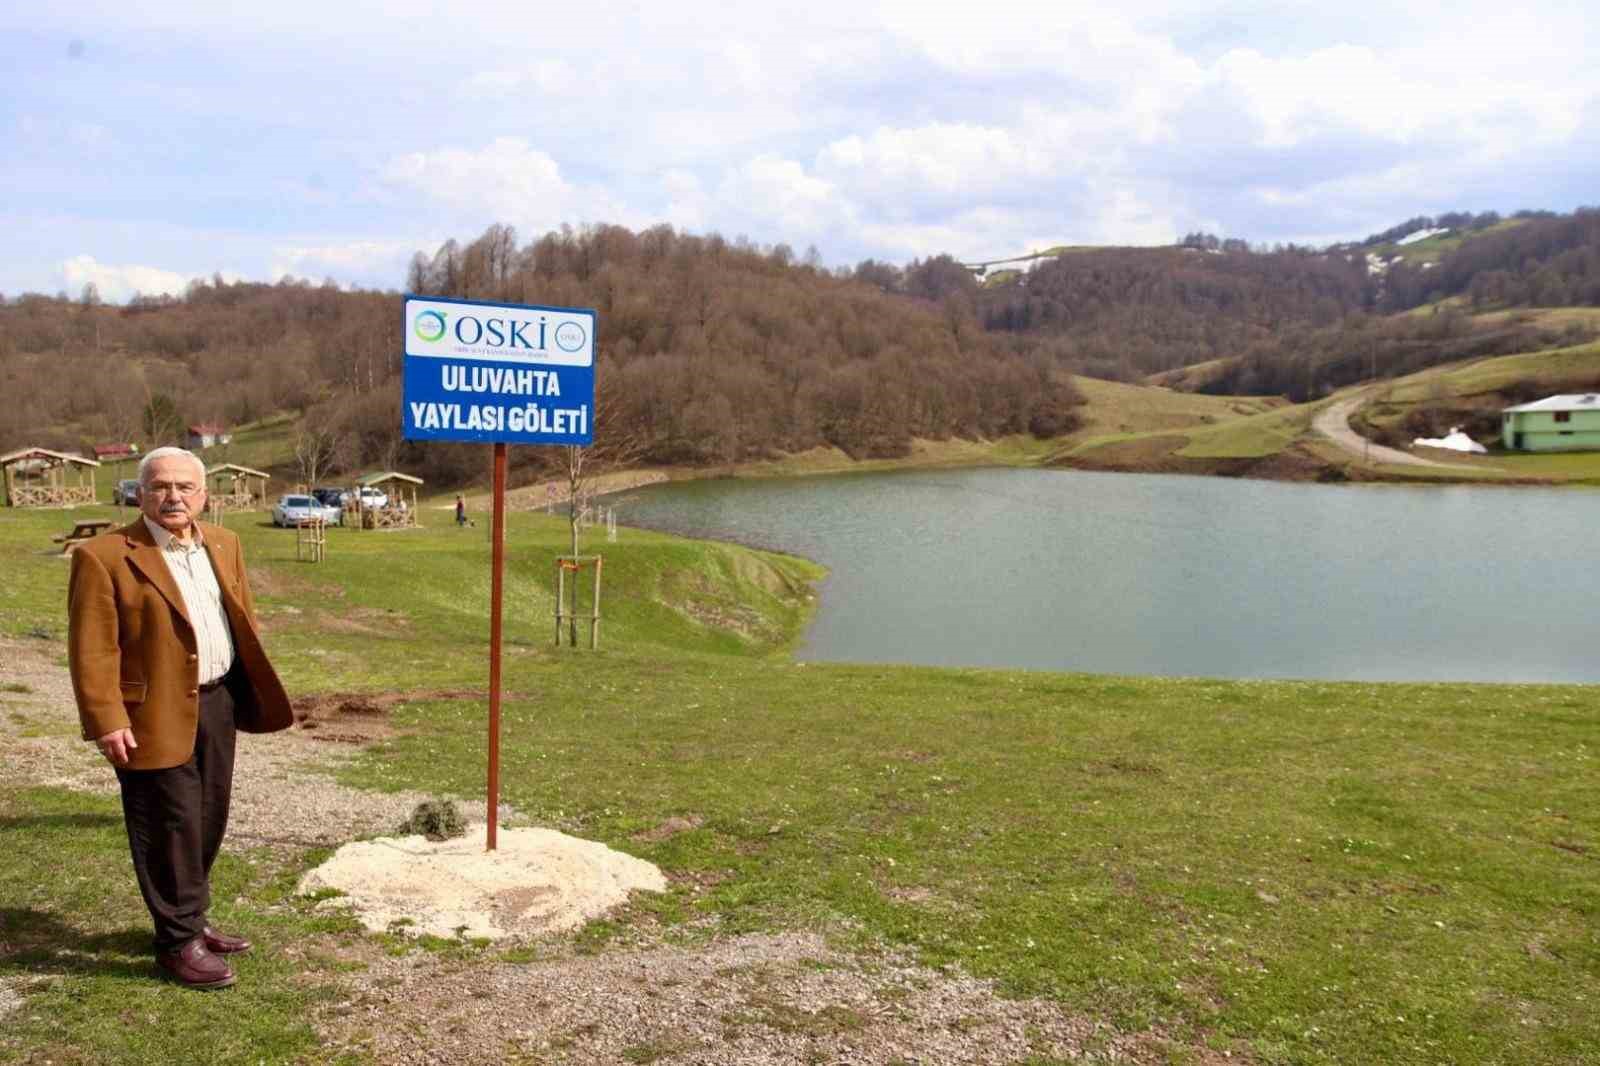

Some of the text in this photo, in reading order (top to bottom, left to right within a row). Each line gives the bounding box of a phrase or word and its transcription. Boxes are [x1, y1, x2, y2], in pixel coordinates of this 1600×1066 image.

[455, 316, 546, 350] OSKİ
[442, 365, 560, 396] ULUVAHTA
[410, 402, 587, 435] YAYLASI GÖLETİ
